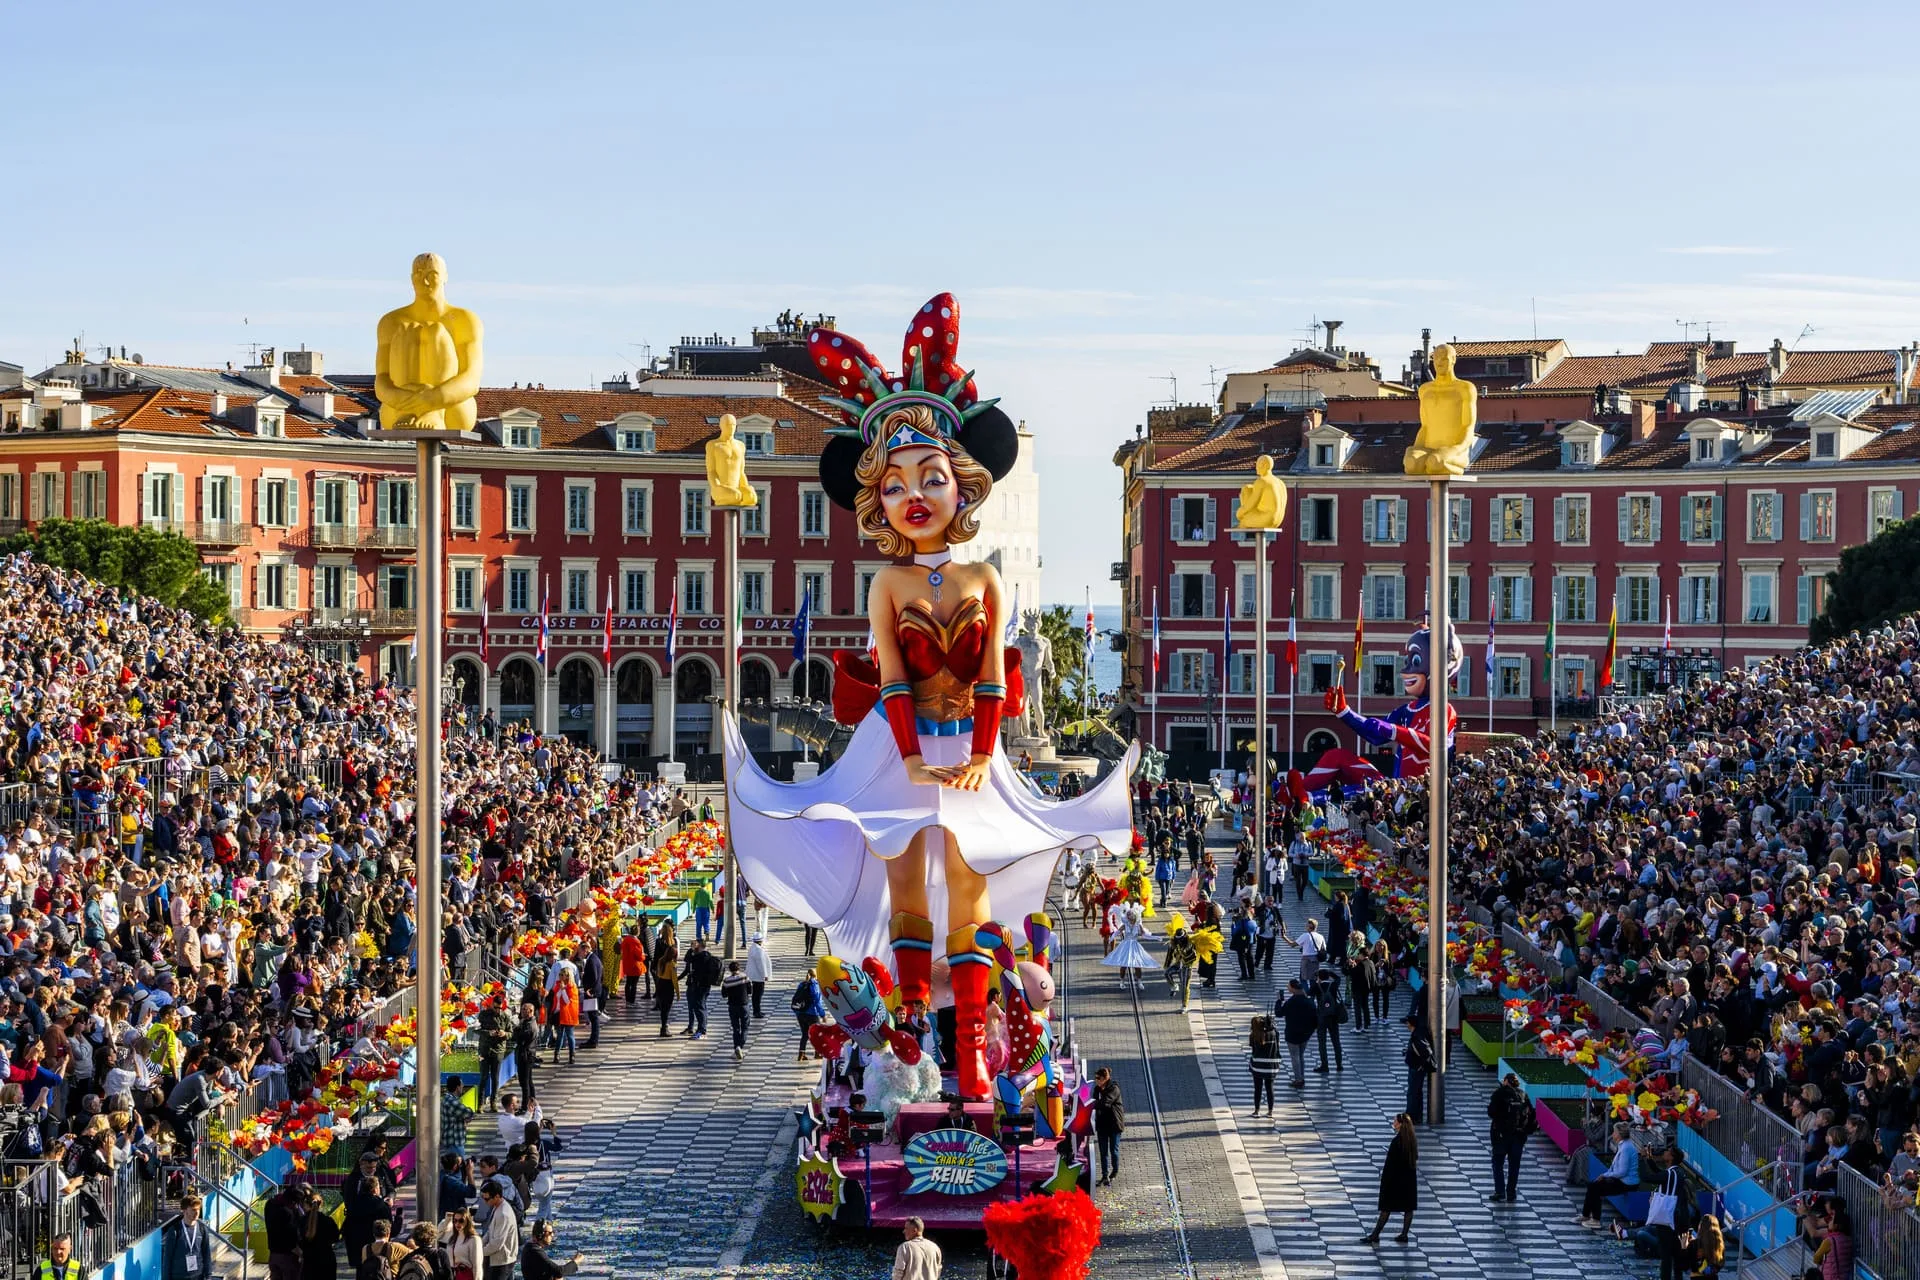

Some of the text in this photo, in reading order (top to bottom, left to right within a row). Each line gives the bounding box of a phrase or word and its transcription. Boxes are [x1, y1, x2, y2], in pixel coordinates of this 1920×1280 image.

[520, 617, 577, 628] CASSE
[754, 619, 813, 630] D'AZR
[935, 1155, 958, 1165] CHAR
[931, 1166, 976, 1185] REINE
